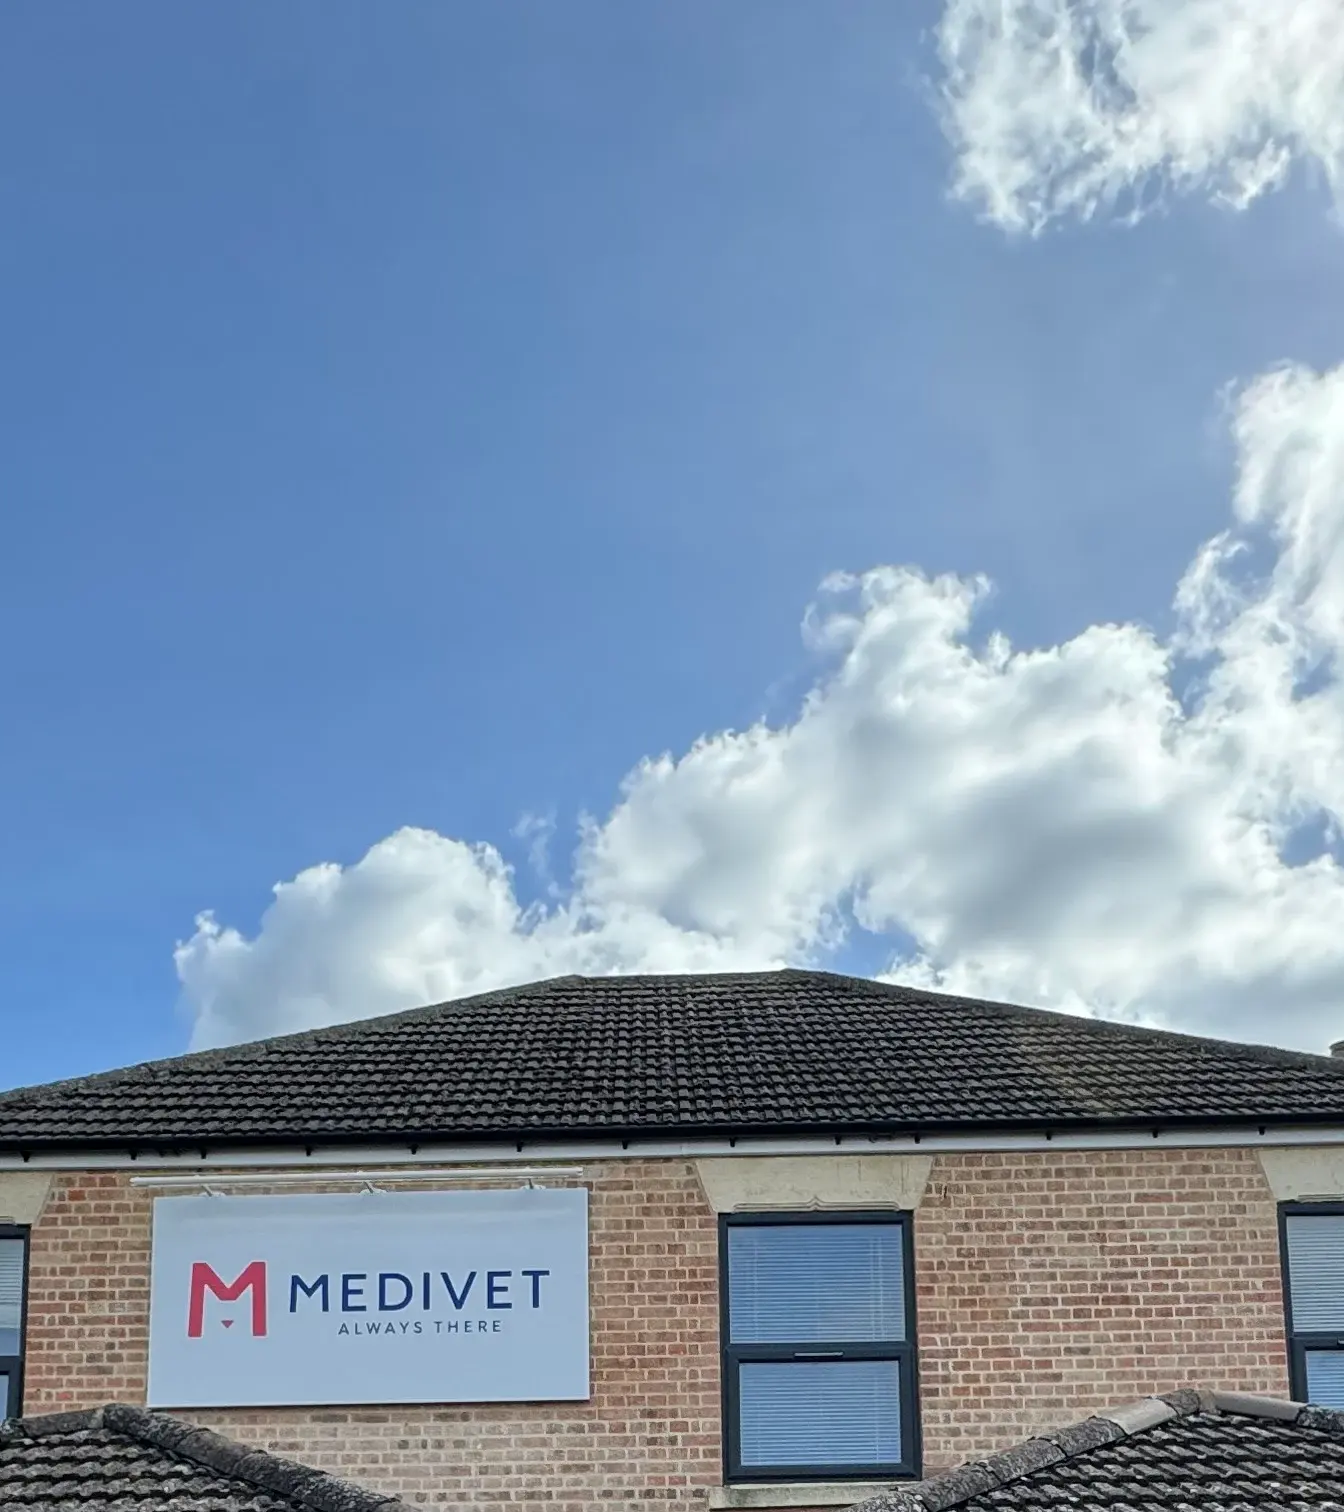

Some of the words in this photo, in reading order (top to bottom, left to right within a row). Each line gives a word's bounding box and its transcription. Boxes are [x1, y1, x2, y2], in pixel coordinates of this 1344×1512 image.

[188, 1261, 267, 1337] M
[289, 1270, 550, 1312] MEDIVET
[338, 1321, 423, 1336] ALWAYS
[434, 1320, 501, 1335] THERE
